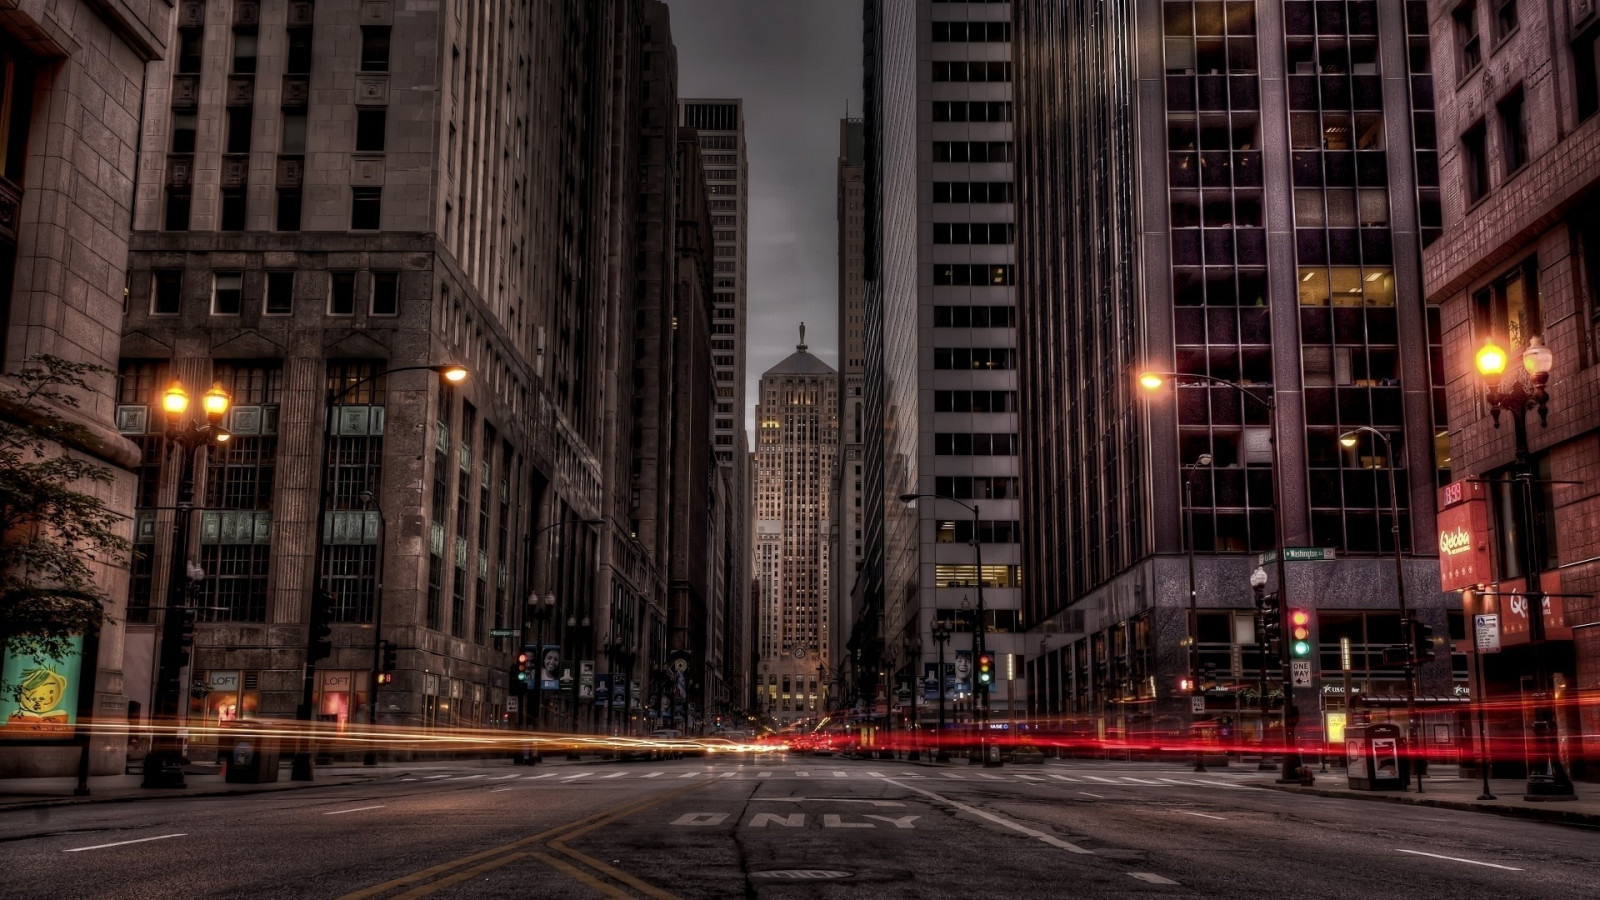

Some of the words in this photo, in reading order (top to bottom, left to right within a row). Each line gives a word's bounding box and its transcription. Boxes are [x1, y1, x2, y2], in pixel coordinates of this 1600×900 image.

[1440, 526, 1470, 555] Qdoba
[1290, 550, 1318, 559] Washington
[211, 676, 236, 686] LOFT
[324, 677, 350, 686] LOFT
[669, 812, 922, 829] ONLY
